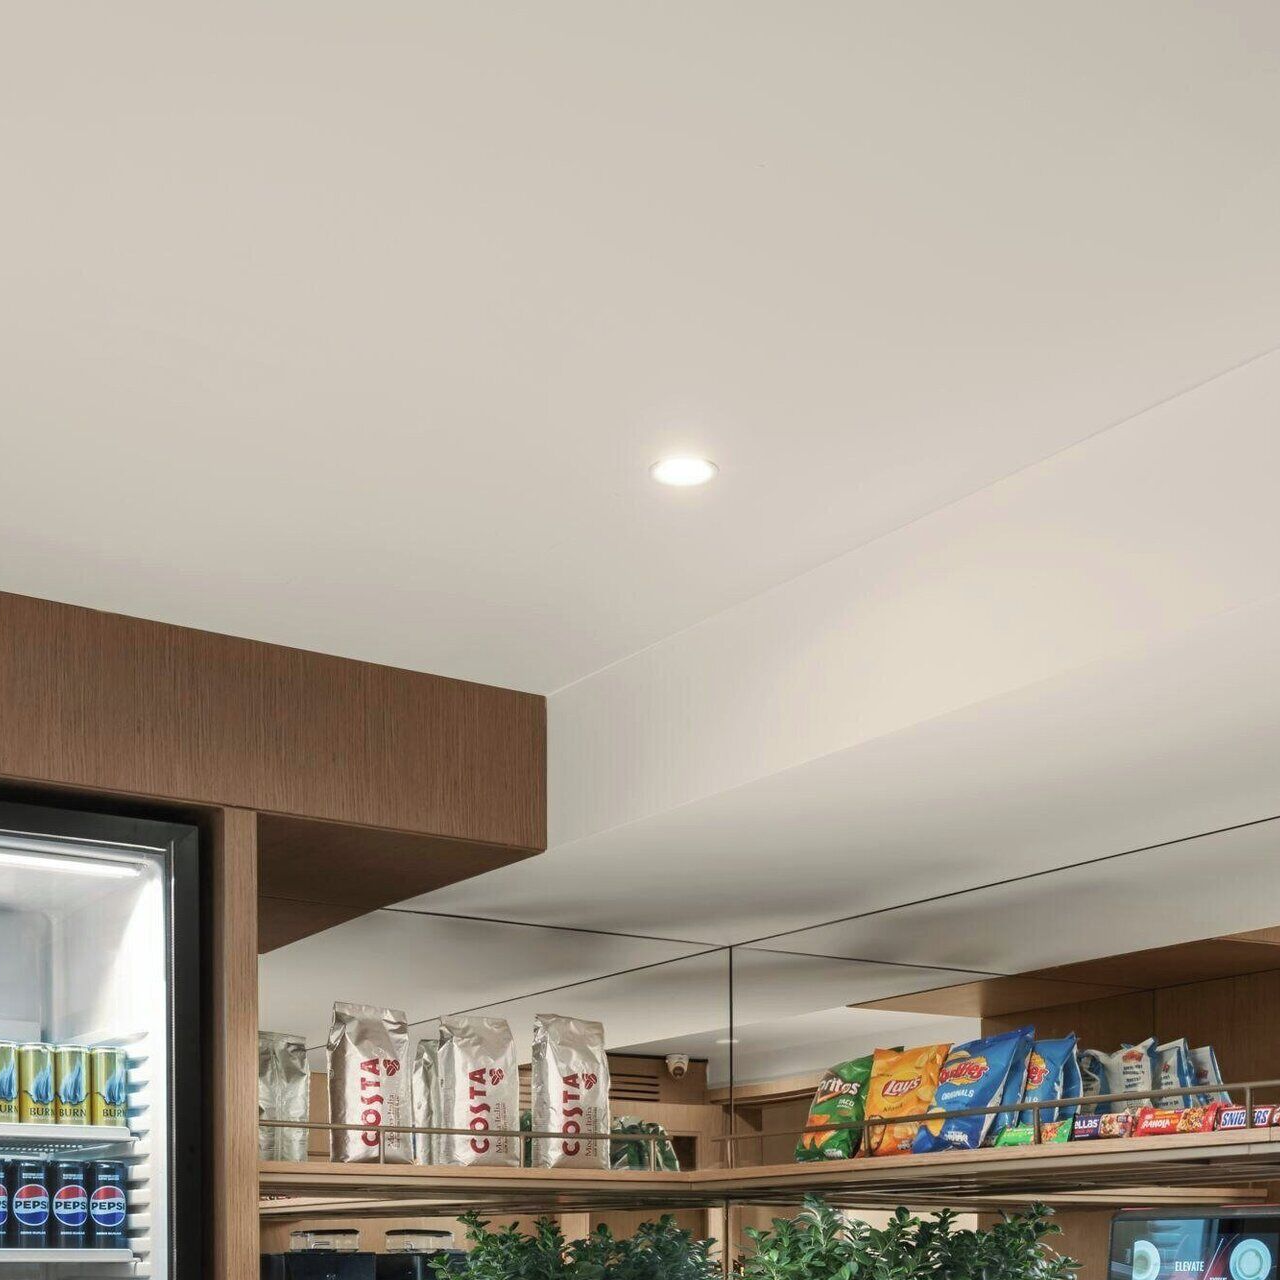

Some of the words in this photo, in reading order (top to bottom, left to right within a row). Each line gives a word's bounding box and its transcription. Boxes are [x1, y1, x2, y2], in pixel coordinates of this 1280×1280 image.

[818, 1077, 861, 1096] oritos
[360, 1058, 384, 1147] COSTA
[468, 1067, 491, 1154] COSTA
[561, 1072, 583, 1156] COSTA
[1221, 1110, 1270, 1127] SNICRS
[55, 1201, 87, 1210] PEPS
[1175, 1261, 1205, 1272] ELEVATE
